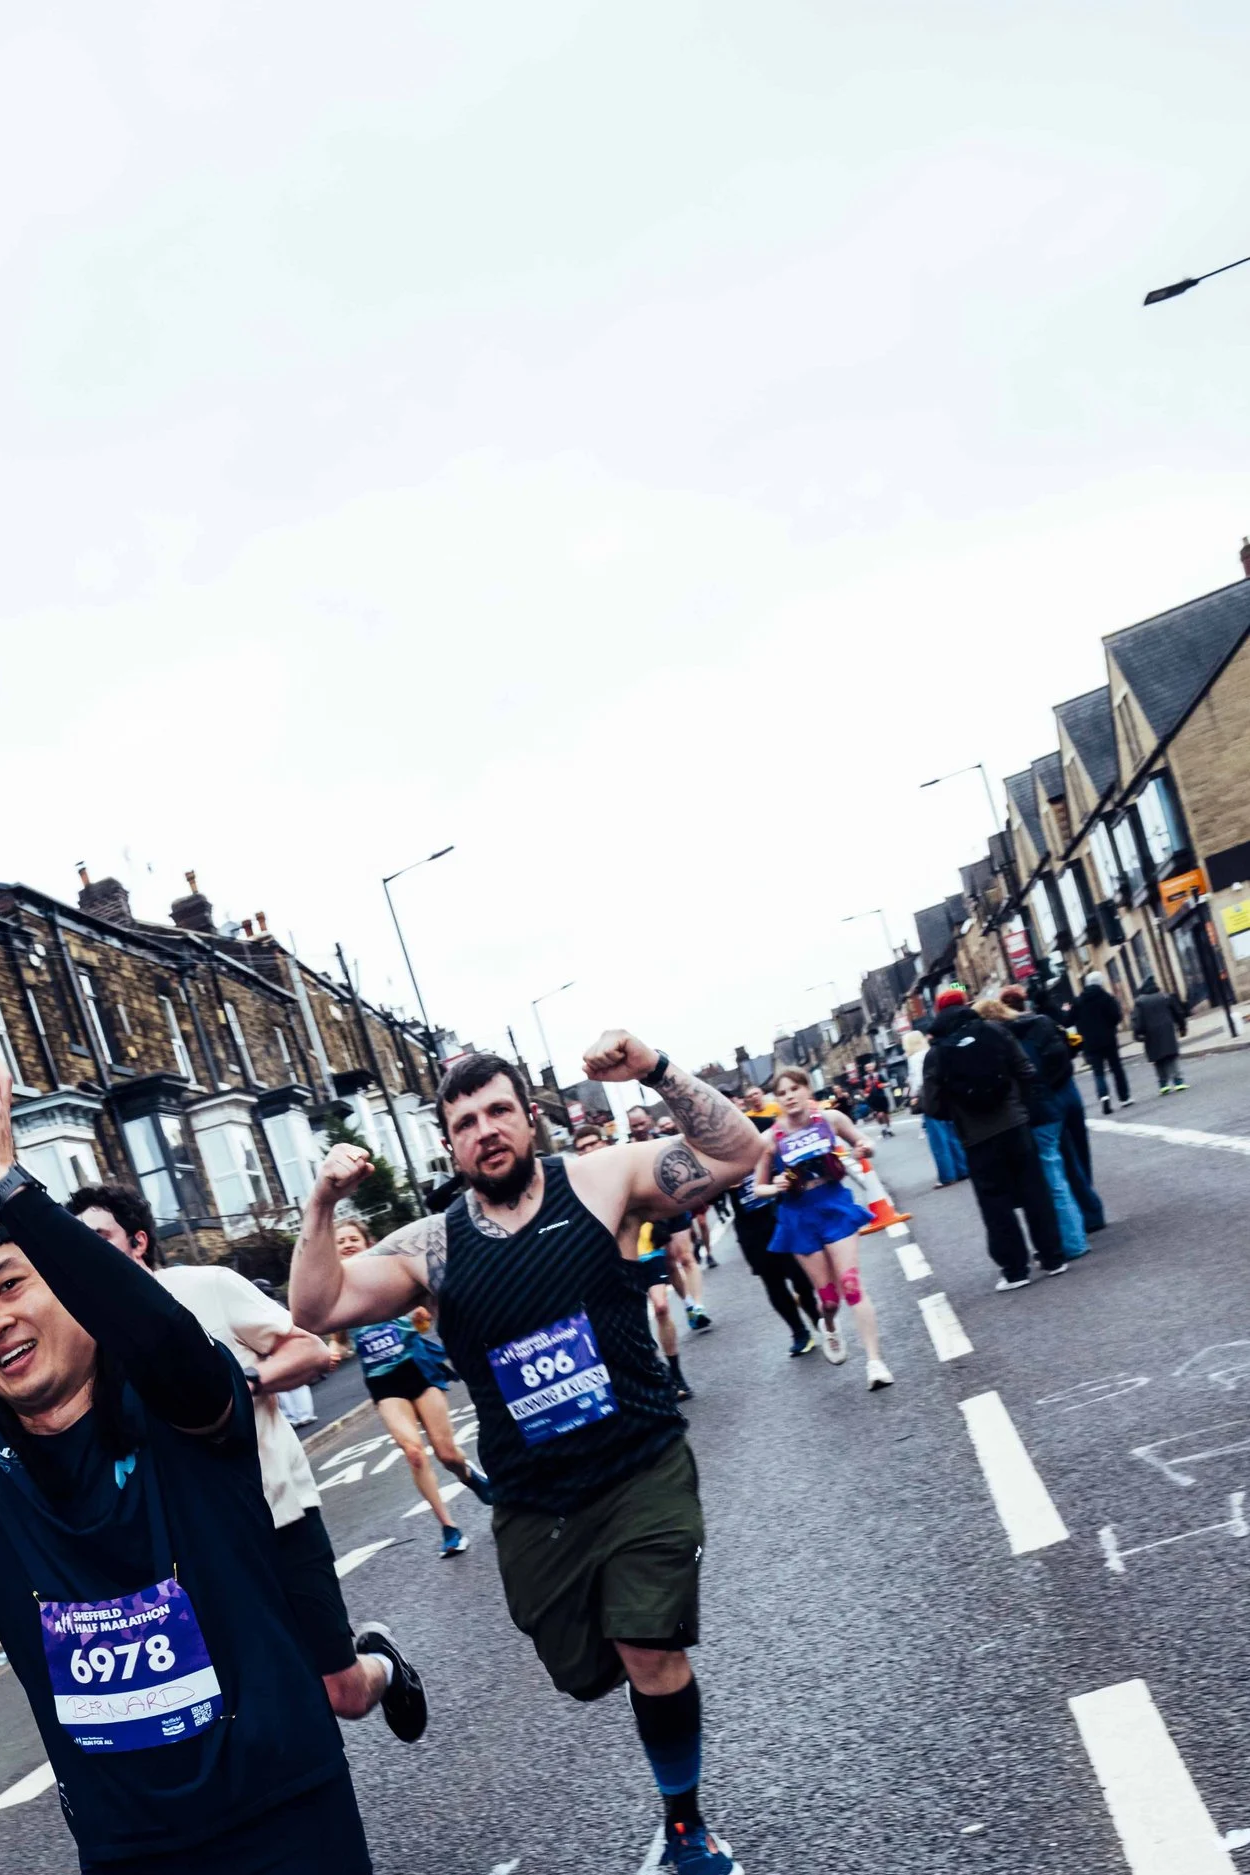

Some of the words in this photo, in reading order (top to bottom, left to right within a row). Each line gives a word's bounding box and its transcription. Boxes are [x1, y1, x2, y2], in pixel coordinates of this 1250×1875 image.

[519, 1349, 576, 1388] 896
[72, 1607, 123, 1622] SHEFFIELD
[74, 1622, 99, 1634] HALF
[100, 1603, 171, 1632] MARATHON
[70, 1633, 176, 1685] 6978
[65, 1684, 196, 1719] BERNARD
